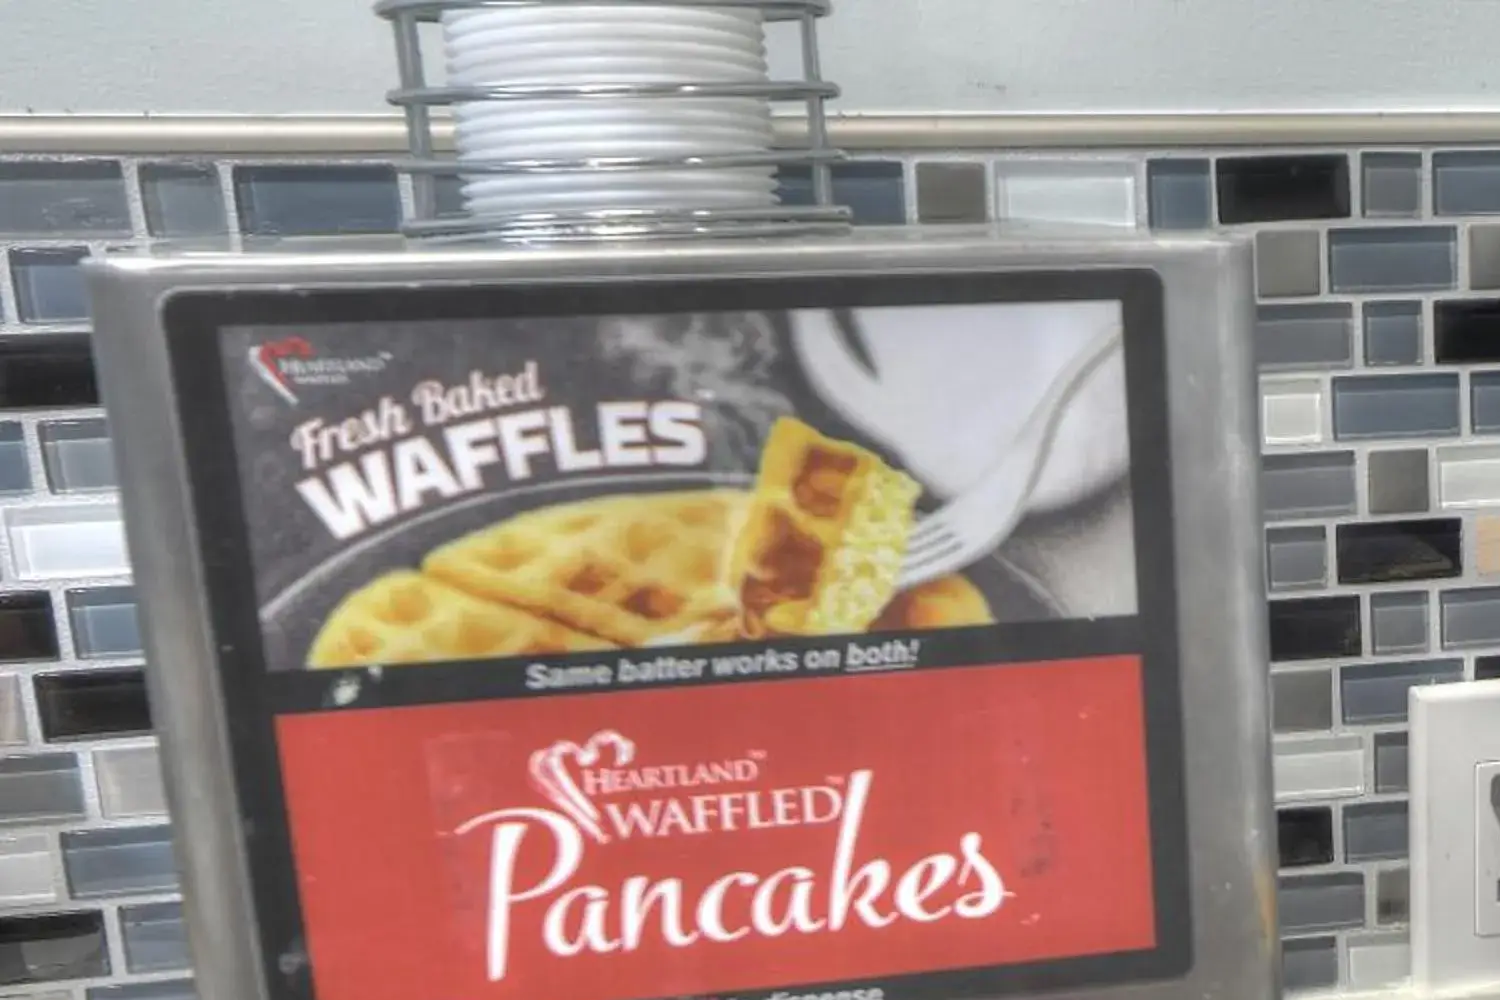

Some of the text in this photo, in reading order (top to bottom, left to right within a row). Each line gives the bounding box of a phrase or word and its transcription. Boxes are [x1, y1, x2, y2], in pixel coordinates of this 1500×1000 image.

[291, 360, 545, 469] Fresh Baked
[295, 401, 707, 541] WAFFLES
[525, 639, 921, 690] Same batter works on both!
[582, 759, 758, 795] HEARTLAND
[603, 785, 843, 840] WAFFLED
[442, 769, 1015, 982] Pancakes
